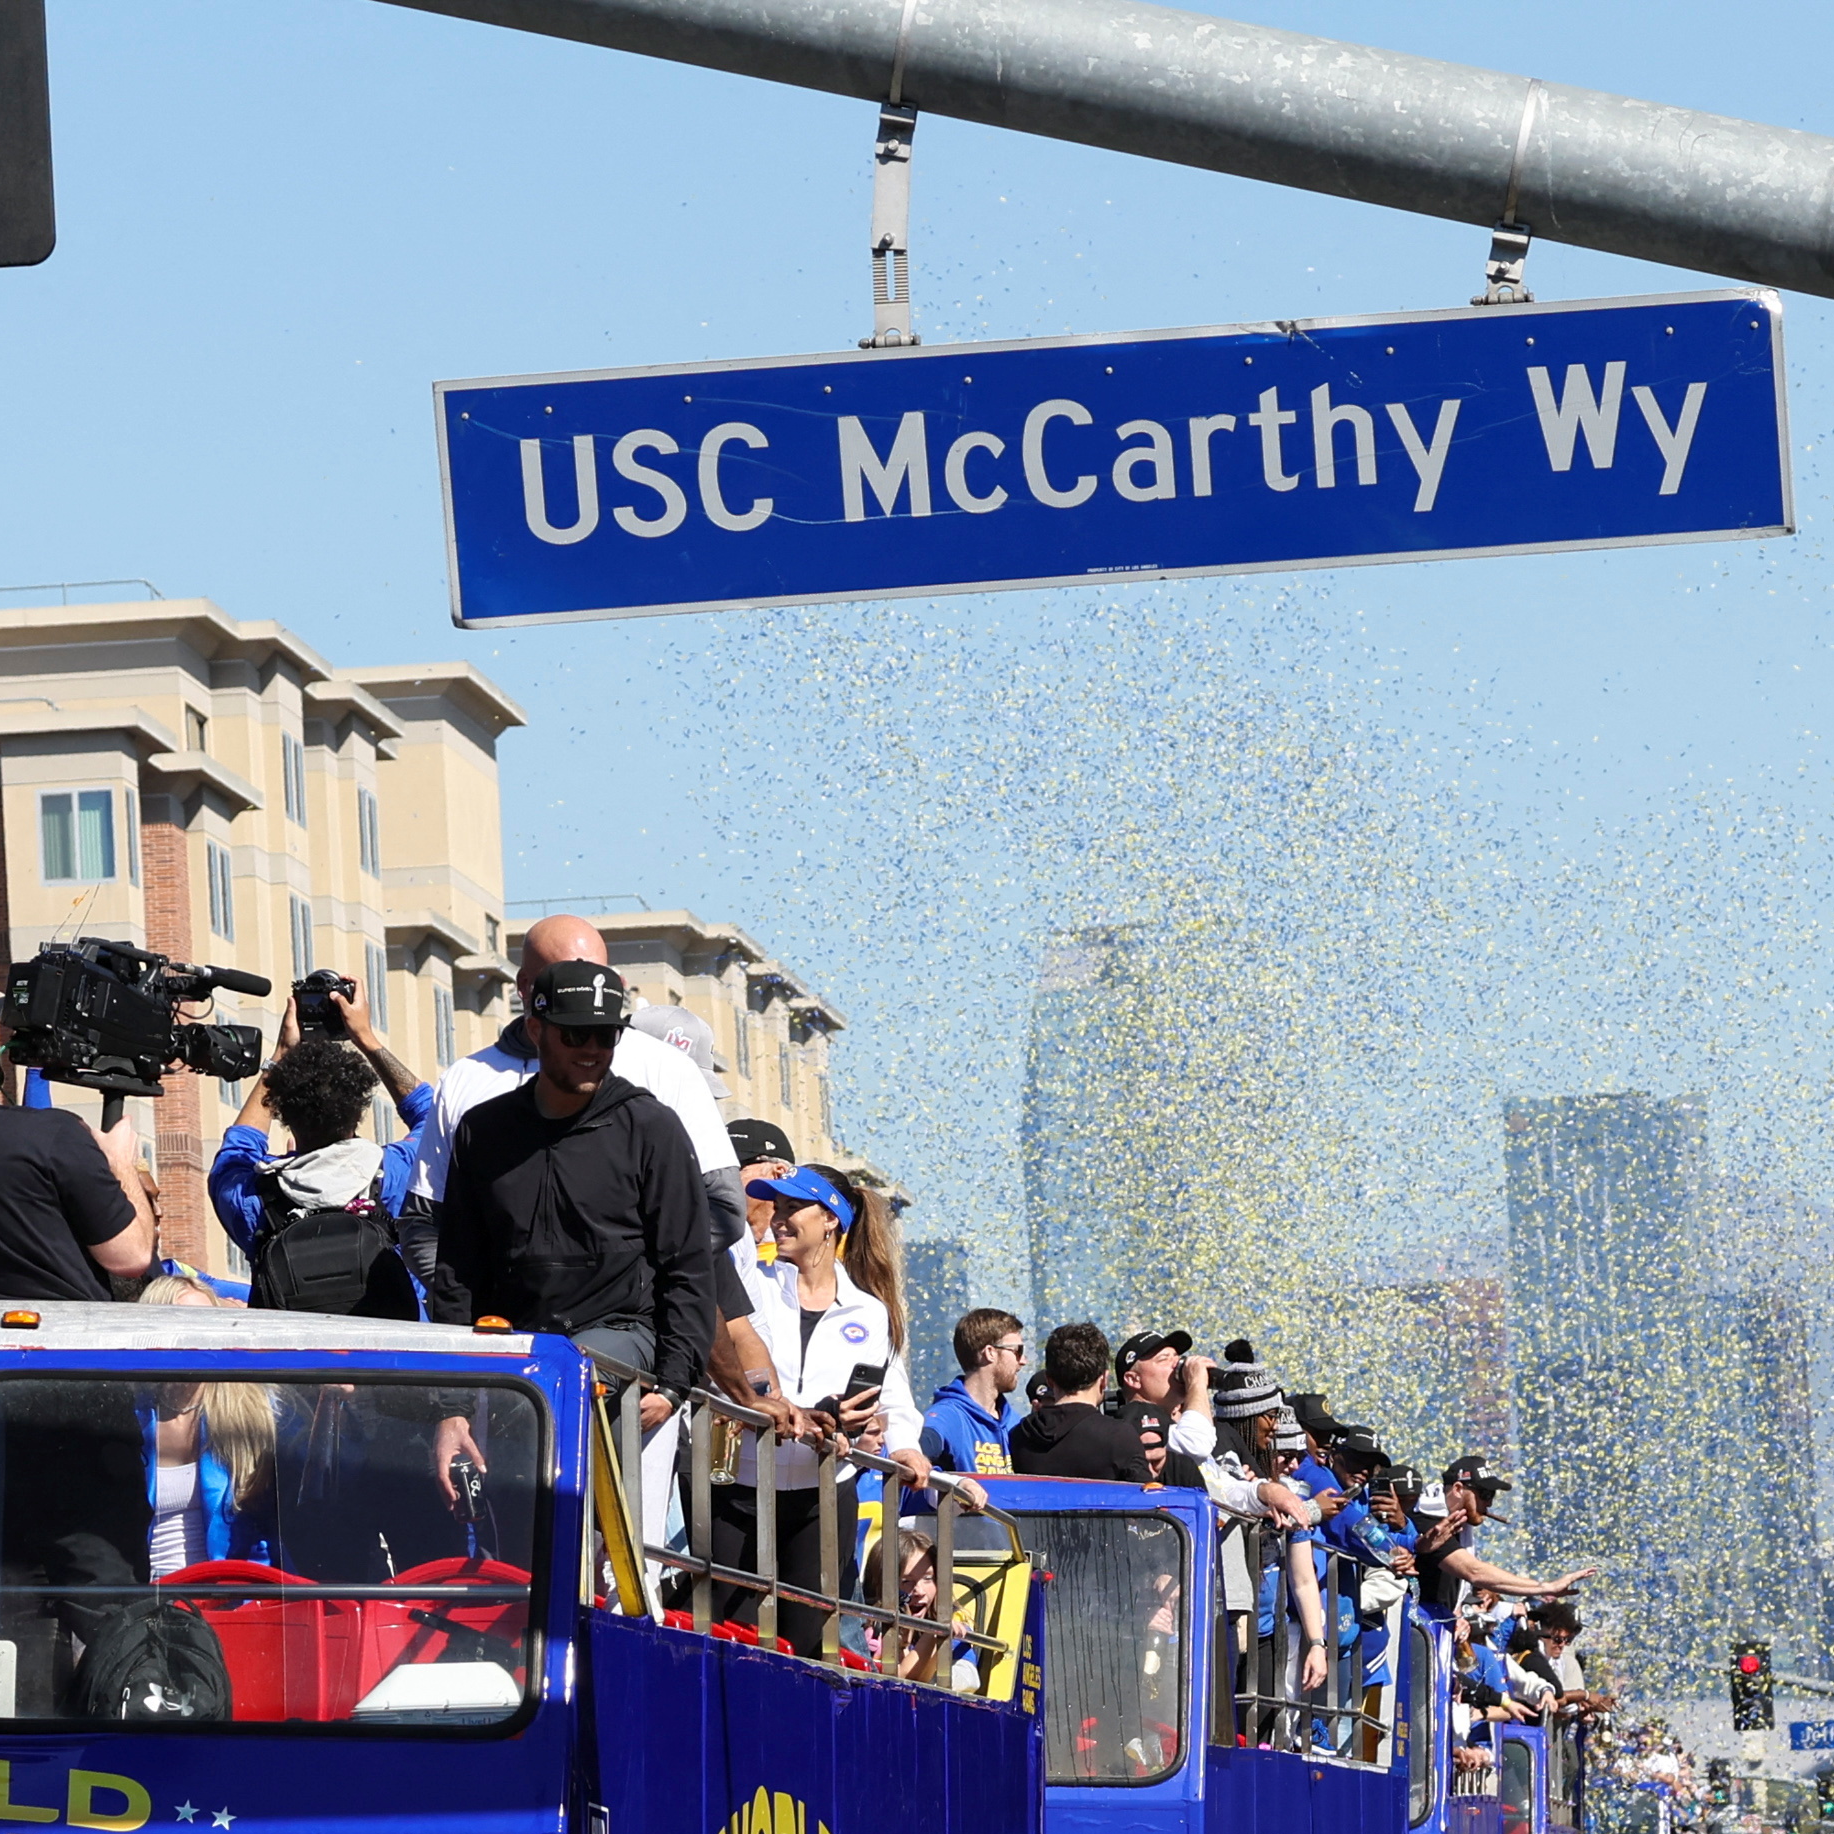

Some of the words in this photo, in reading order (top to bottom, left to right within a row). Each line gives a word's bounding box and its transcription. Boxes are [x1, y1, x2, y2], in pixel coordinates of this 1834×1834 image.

[520, 421, 774, 546] USC
[839, 382, 1461, 524] McCarthy
[1526, 360, 1707, 496] Wy
[975, 1440, 1002, 1455] LOS
